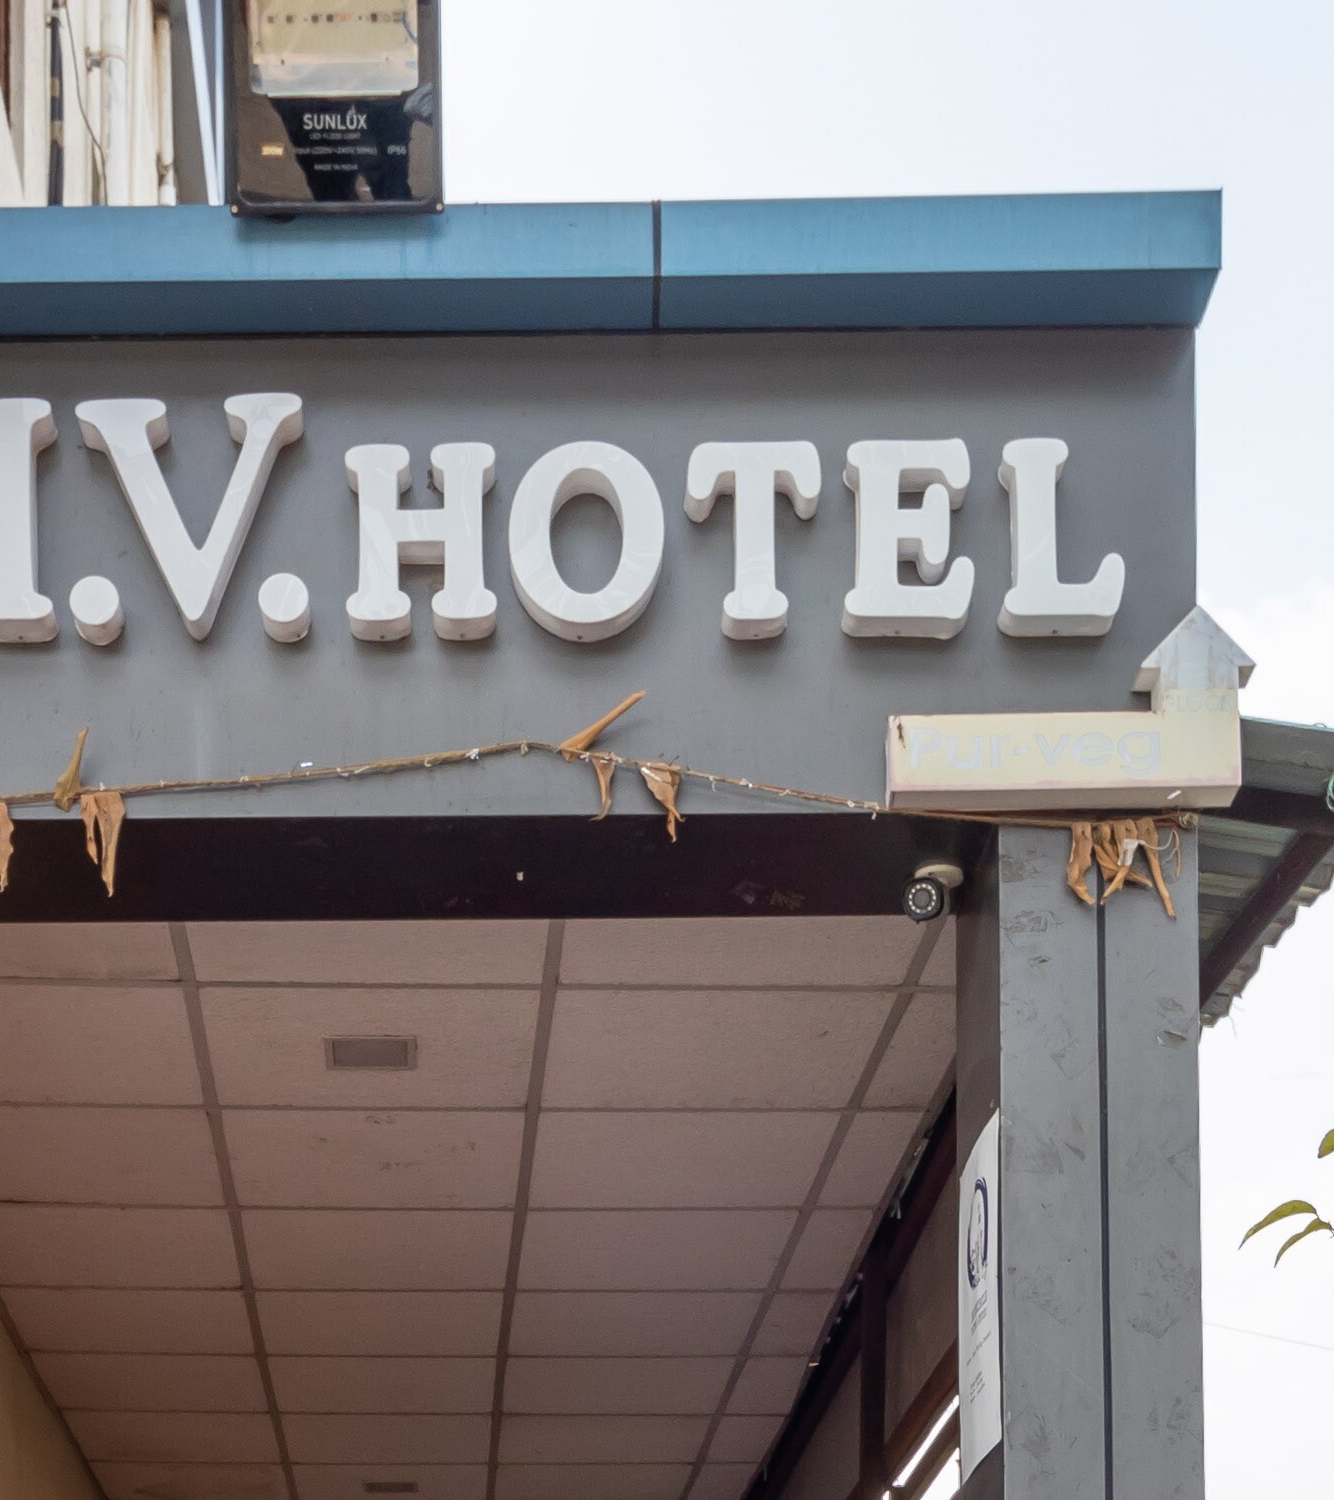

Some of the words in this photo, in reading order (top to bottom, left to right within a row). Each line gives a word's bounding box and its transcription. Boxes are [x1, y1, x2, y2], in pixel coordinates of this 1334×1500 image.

[303, 112, 367, 130] SUNLUX
[345, 438, 1125, 642] HOTEL
[908, 726, 1162, 775] Pur-veg
